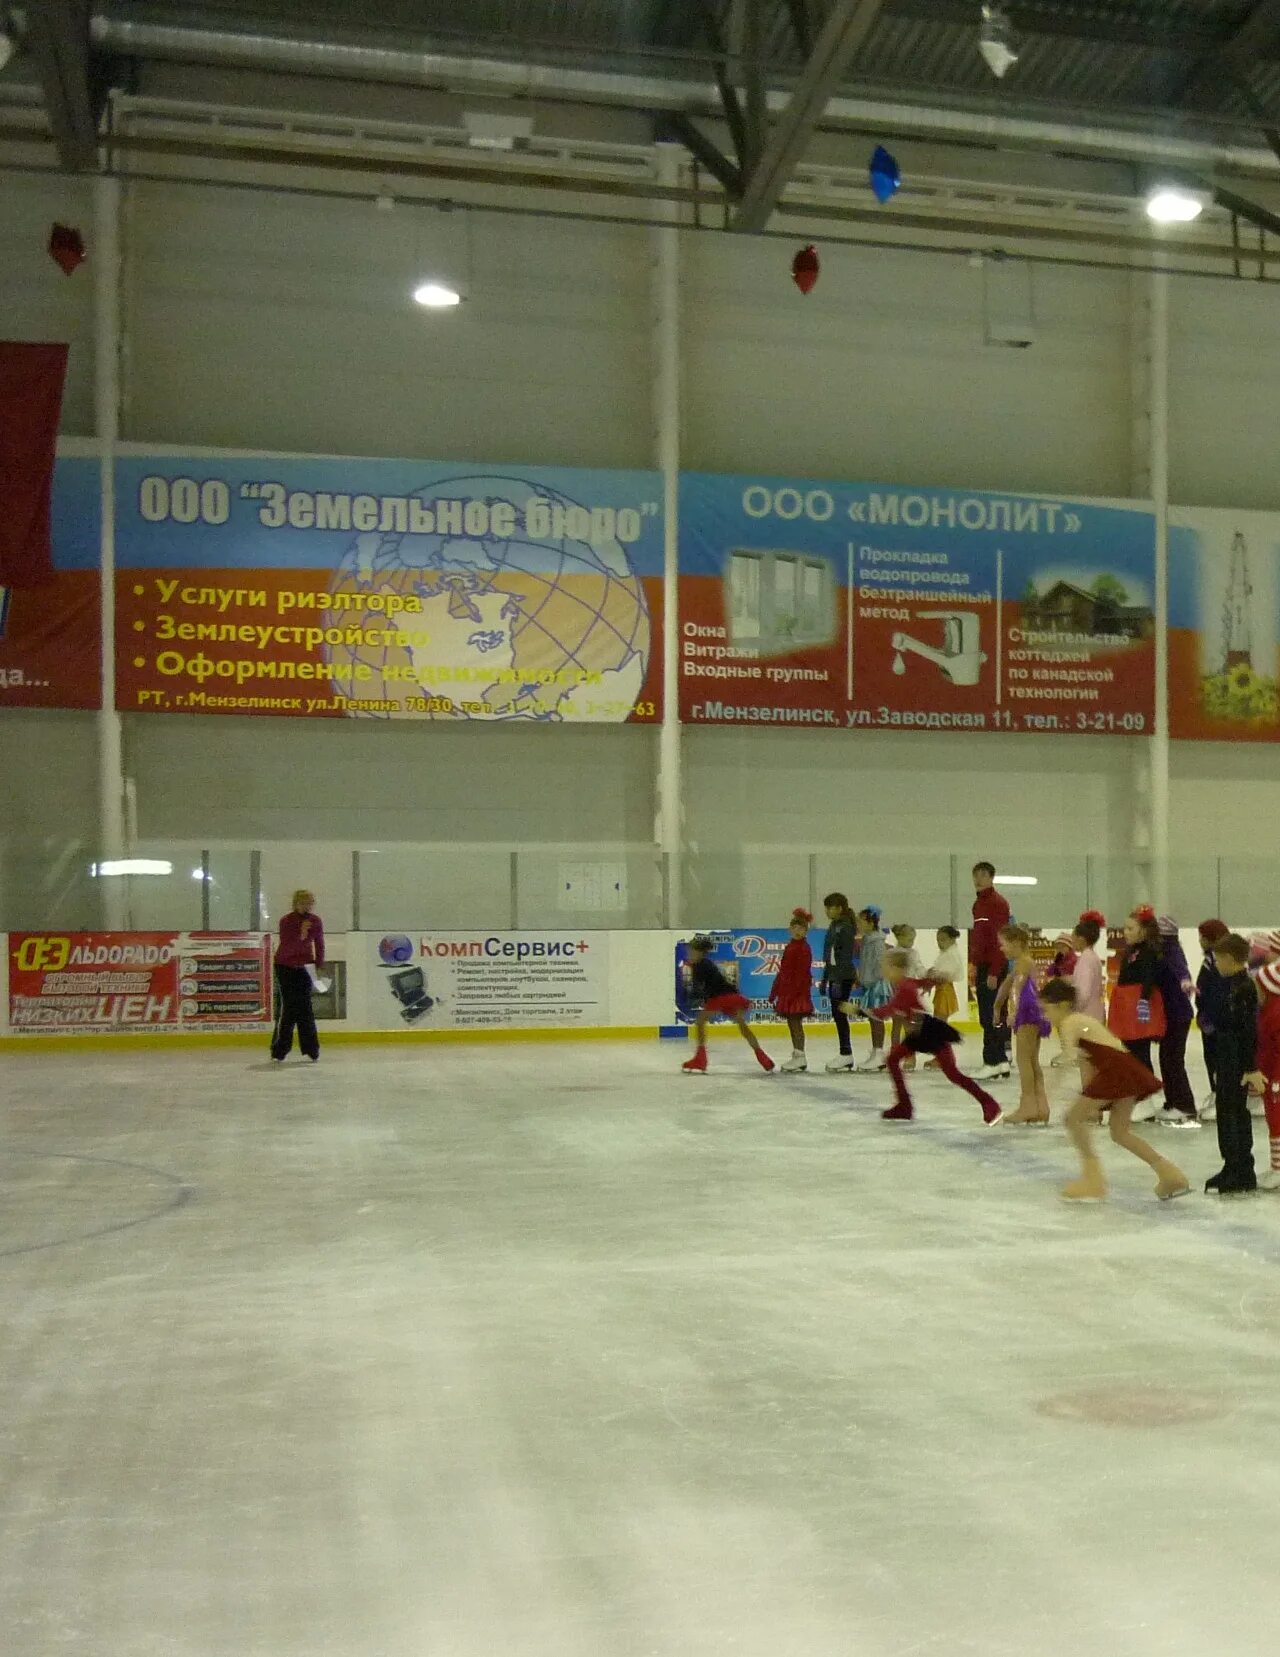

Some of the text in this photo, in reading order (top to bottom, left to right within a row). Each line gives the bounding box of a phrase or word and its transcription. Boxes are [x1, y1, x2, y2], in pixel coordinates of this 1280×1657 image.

[140, 475, 659, 547] ООО “Земельное бюро”
[742, 485, 1082, 534] ООО «МОНОЛИТ»
[859, 546, 949, 565] Прокладка
[859, 568, 970, 586] водопровода
[154, 578, 424, 620] Услуги риэлтора
[859, 606, 911, 621] метод
[155, 614, 431, 651] Землеустройство
[683, 622, 727, 638] Окна
[1008, 627, 1131, 646] Строительство
[683, 641, 760, 660] Витражи
[1008, 649, 1091, 663] коттеджей
[155, 650, 603, 687] Оформление недвижимости
[683, 661, 829, 683] Входные группы
[1008, 668, 1114, 683] по канадской
[137, 690, 171, 708] РТ,
[175, 691, 302, 710] г.Мензелинск
[307, 695, 400, 714] ул.Ленина
[1008, 687, 1100, 701] технологии
[691, 701, 840, 727] г.Мензелинск,
[846, 706, 985, 729] ул.Заводская
[1075, 711, 1146, 731] 3-21-09
[95, 995, 172, 1026] ЦЕН
